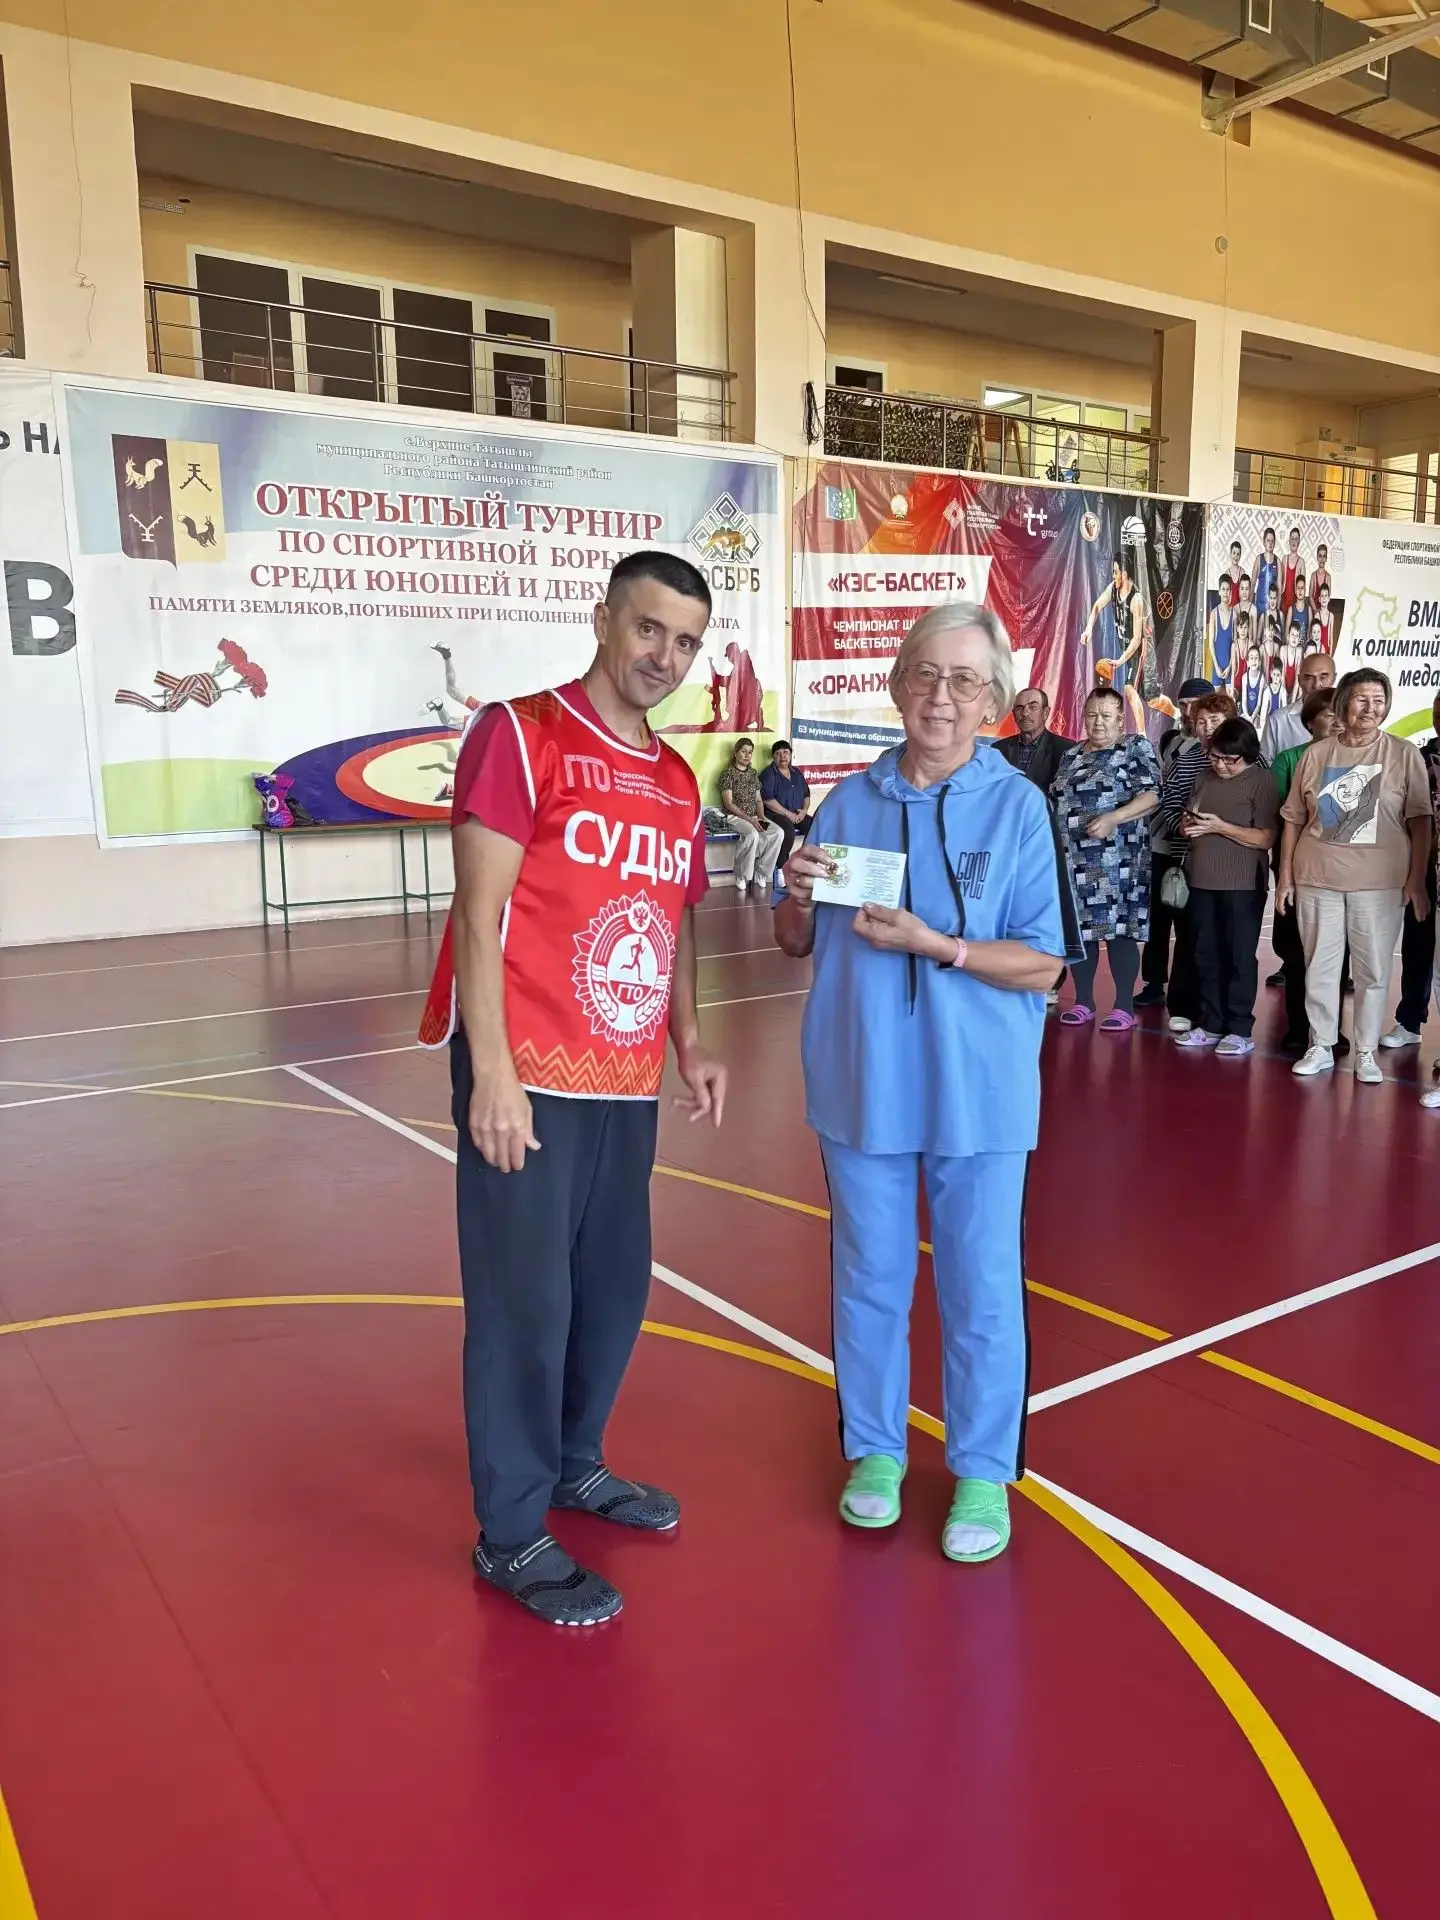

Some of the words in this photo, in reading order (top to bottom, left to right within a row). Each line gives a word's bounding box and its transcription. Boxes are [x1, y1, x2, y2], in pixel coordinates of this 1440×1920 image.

[316, 444, 430, 463] муниципального
[434, 453, 480, 468] района
[483, 458, 574, 477] Татышлинский
[576, 466, 612, 481] район
[384, 464, 461, 480] Республики
[466, 471, 554, 489] Башкортостан
[256, 482, 508, 530] ОТКРЫТЫЙ
[516, 502, 663, 541] ТУРНИР
[277, 529, 326, 554] ПО
[332, 533, 538, 566] СПОРТИВНОЙ
[250, 564, 358, 595] СРЕДИ
[364, 568, 510, 598] ЮНОШЕЙ
[519, 577, 538, 598] И
[545, 579, 609, 604] ДЕВУ
[827, 571, 967, 593] «КЭС-БАСКЕТ»
[149, 595, 237, 613] ПАМЯТИ
[458, 607, 493, 622] ПРИ
[496, 608, 594, 625] ИСПОЛНЕНИ
[708, 617, 741, 630] ОЛГА
[833, 619, 899, 634] ЧЕМПИОНАТ
[834, 637, 903, 650] БАСКЕТБОЛЬ
[1352, 638, 1363, 657] к
[1365, 634, 1440, 658] олимпий
[808, 672, 889, 695] «ОРАНЖ
[1398, 663, 1440, 687] меда
[808, 727, 867, 739] муниципальных
[868, 733, 905, 743] образован
[562, 754, 611, 793] ГТО
[564, 810, 692, 888] СУДЬЯ
[616, 983, 644, 1001] ГТО
